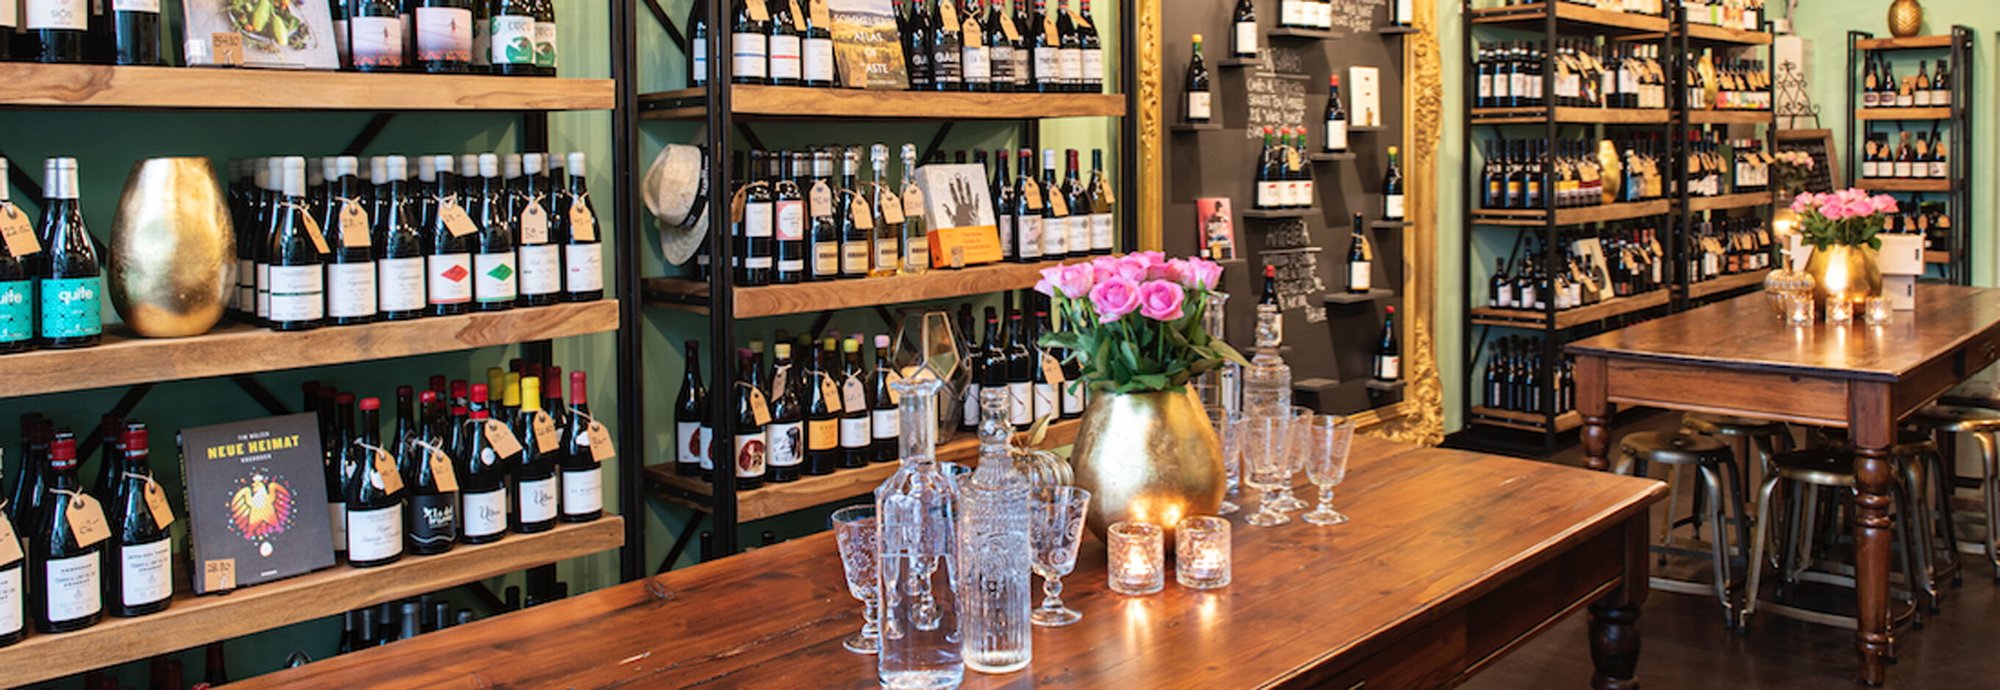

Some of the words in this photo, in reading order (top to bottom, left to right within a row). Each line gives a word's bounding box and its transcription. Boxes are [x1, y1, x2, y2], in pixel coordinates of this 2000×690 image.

[853, 31, 883, 42] ATLAS
[0, 288, 23, 305] uite
[58, 285, 94, 305] quite
[206, 442, 246, 460] NEUE
[247, 434, 300, 454] HEIMAT
